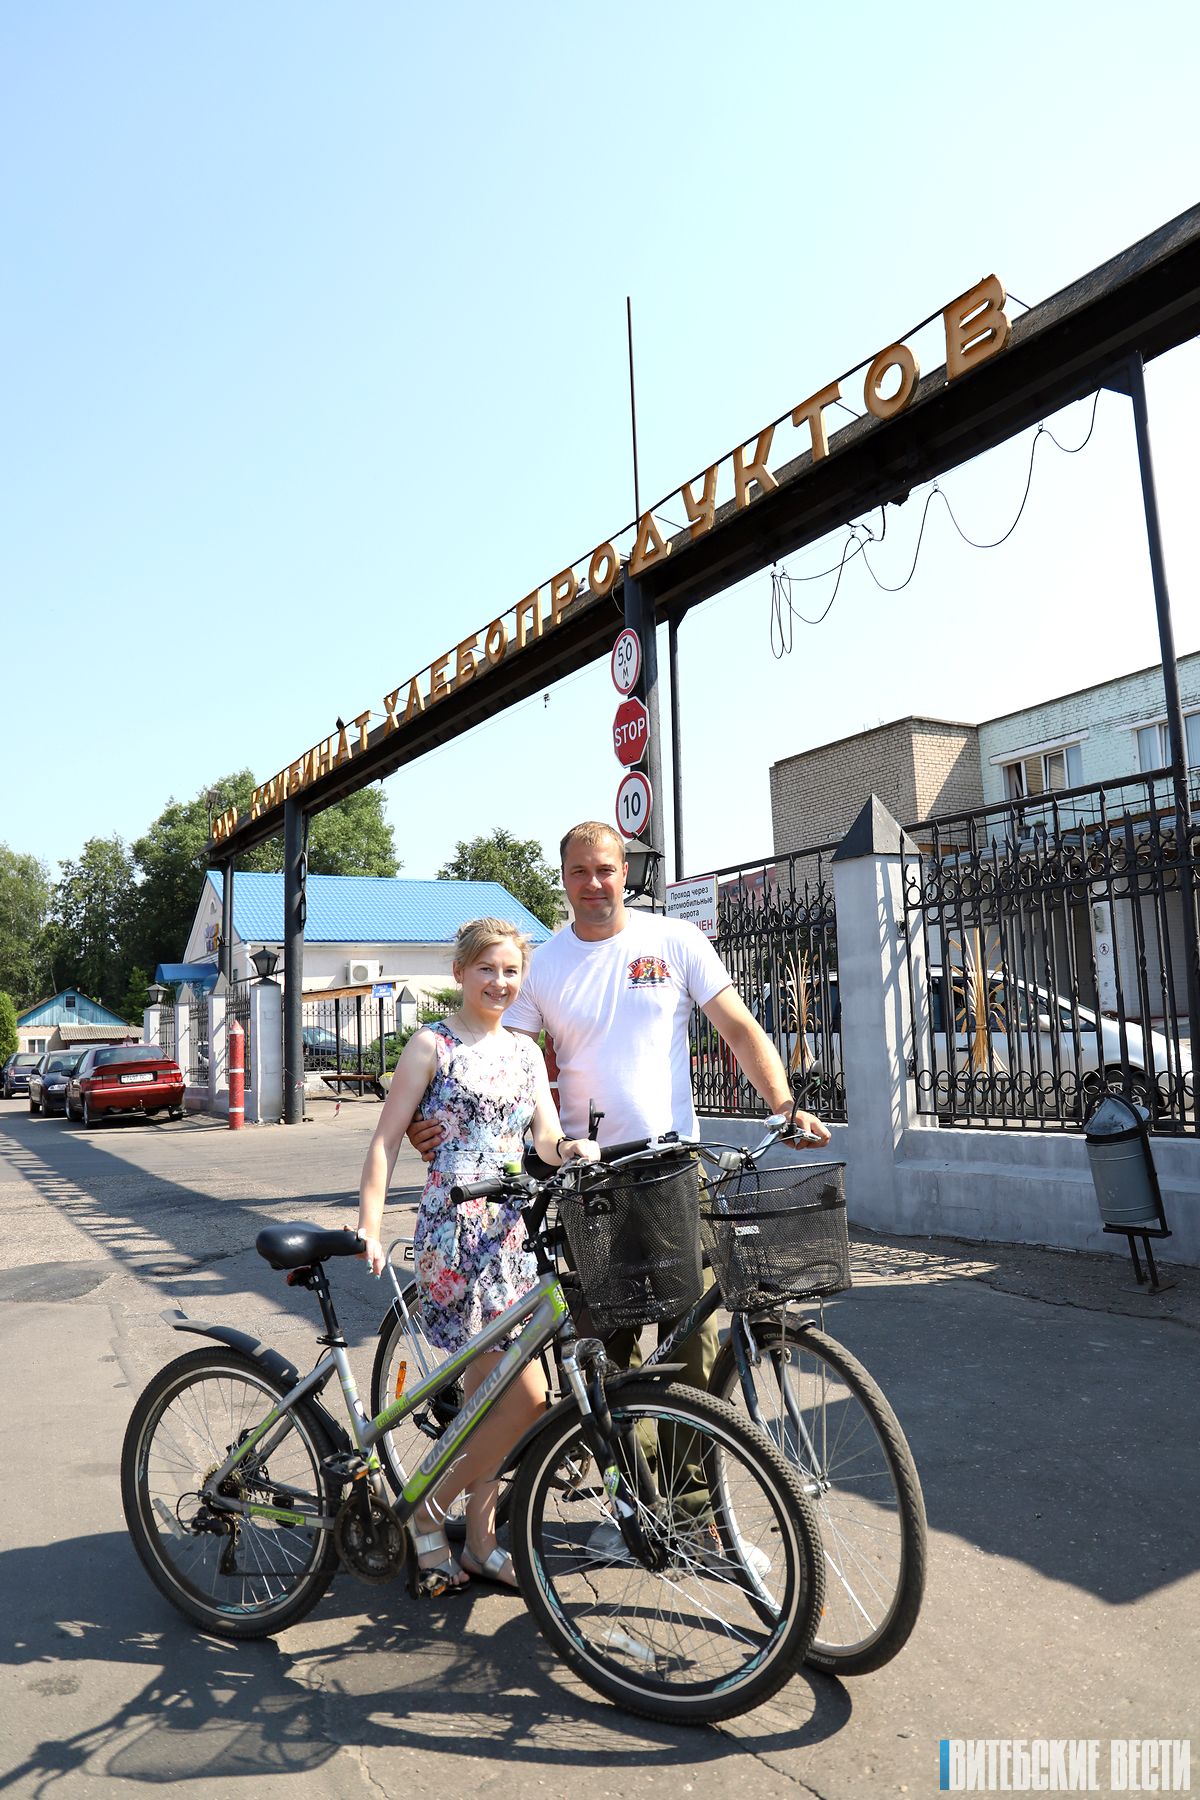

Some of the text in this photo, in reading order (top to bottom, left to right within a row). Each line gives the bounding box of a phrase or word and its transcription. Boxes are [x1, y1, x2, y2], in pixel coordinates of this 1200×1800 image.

[252, 709, 372, 821] КОМБИНАТ
[383, 273, 1013, 737] ХЛЕБОПРОДУКТОВ
[614, 717, 645, 747] STOP
[623, 791, 641, 819] 10
[667, 896, 713, 912] автомобильные
[670, 886, 709, 901] Проход через
[679, 909, 700, 920] ворота
[423, 1367, 502, 1474] GREENWAY
